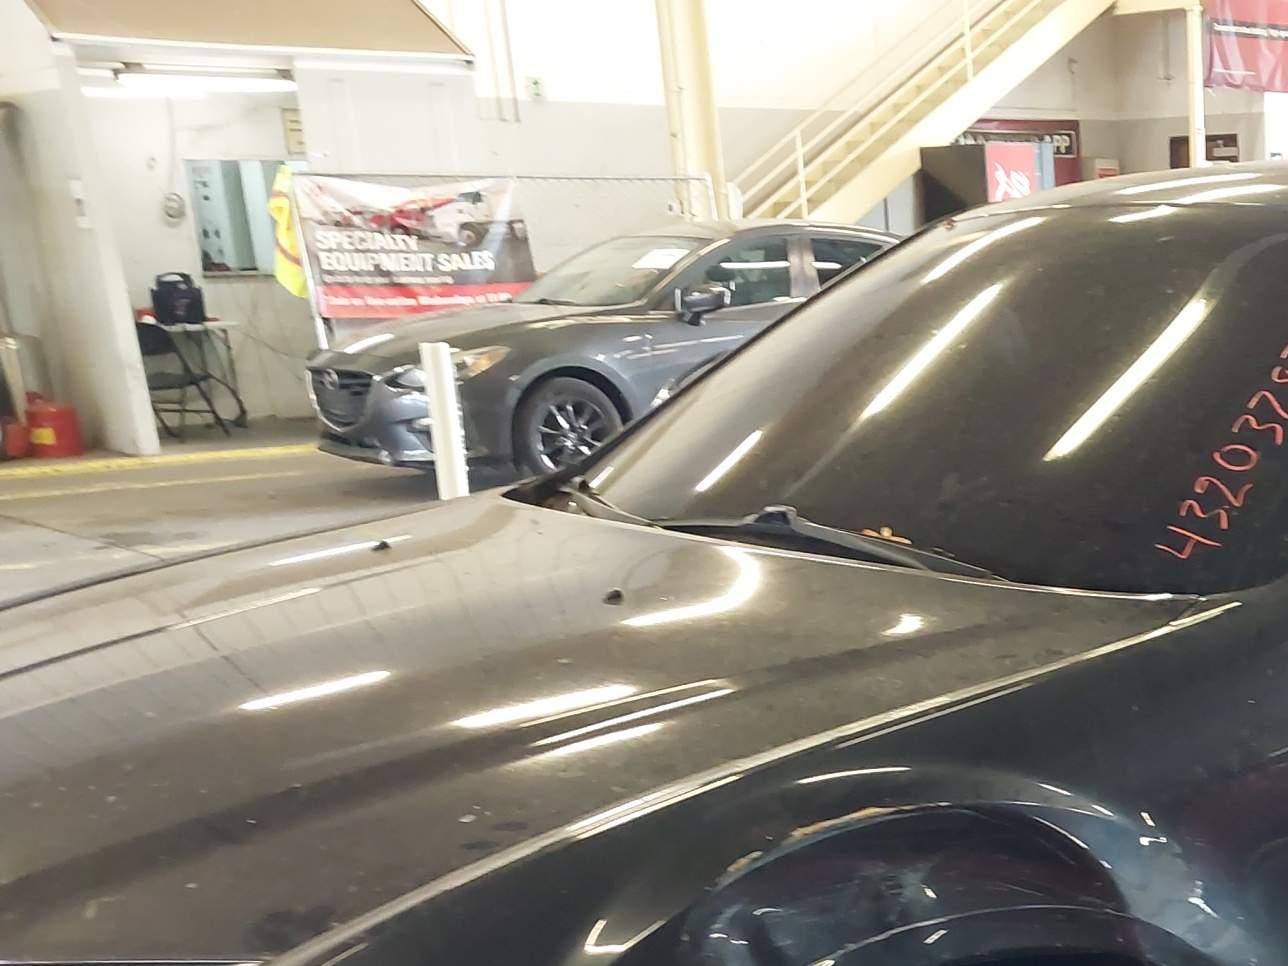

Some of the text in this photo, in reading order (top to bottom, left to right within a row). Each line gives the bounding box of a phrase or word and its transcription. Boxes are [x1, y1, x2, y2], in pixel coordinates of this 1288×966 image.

[315, 230, 419, 251] SPECIALTY
[318, 250, 496, 272] EQUIPMENT SALES
